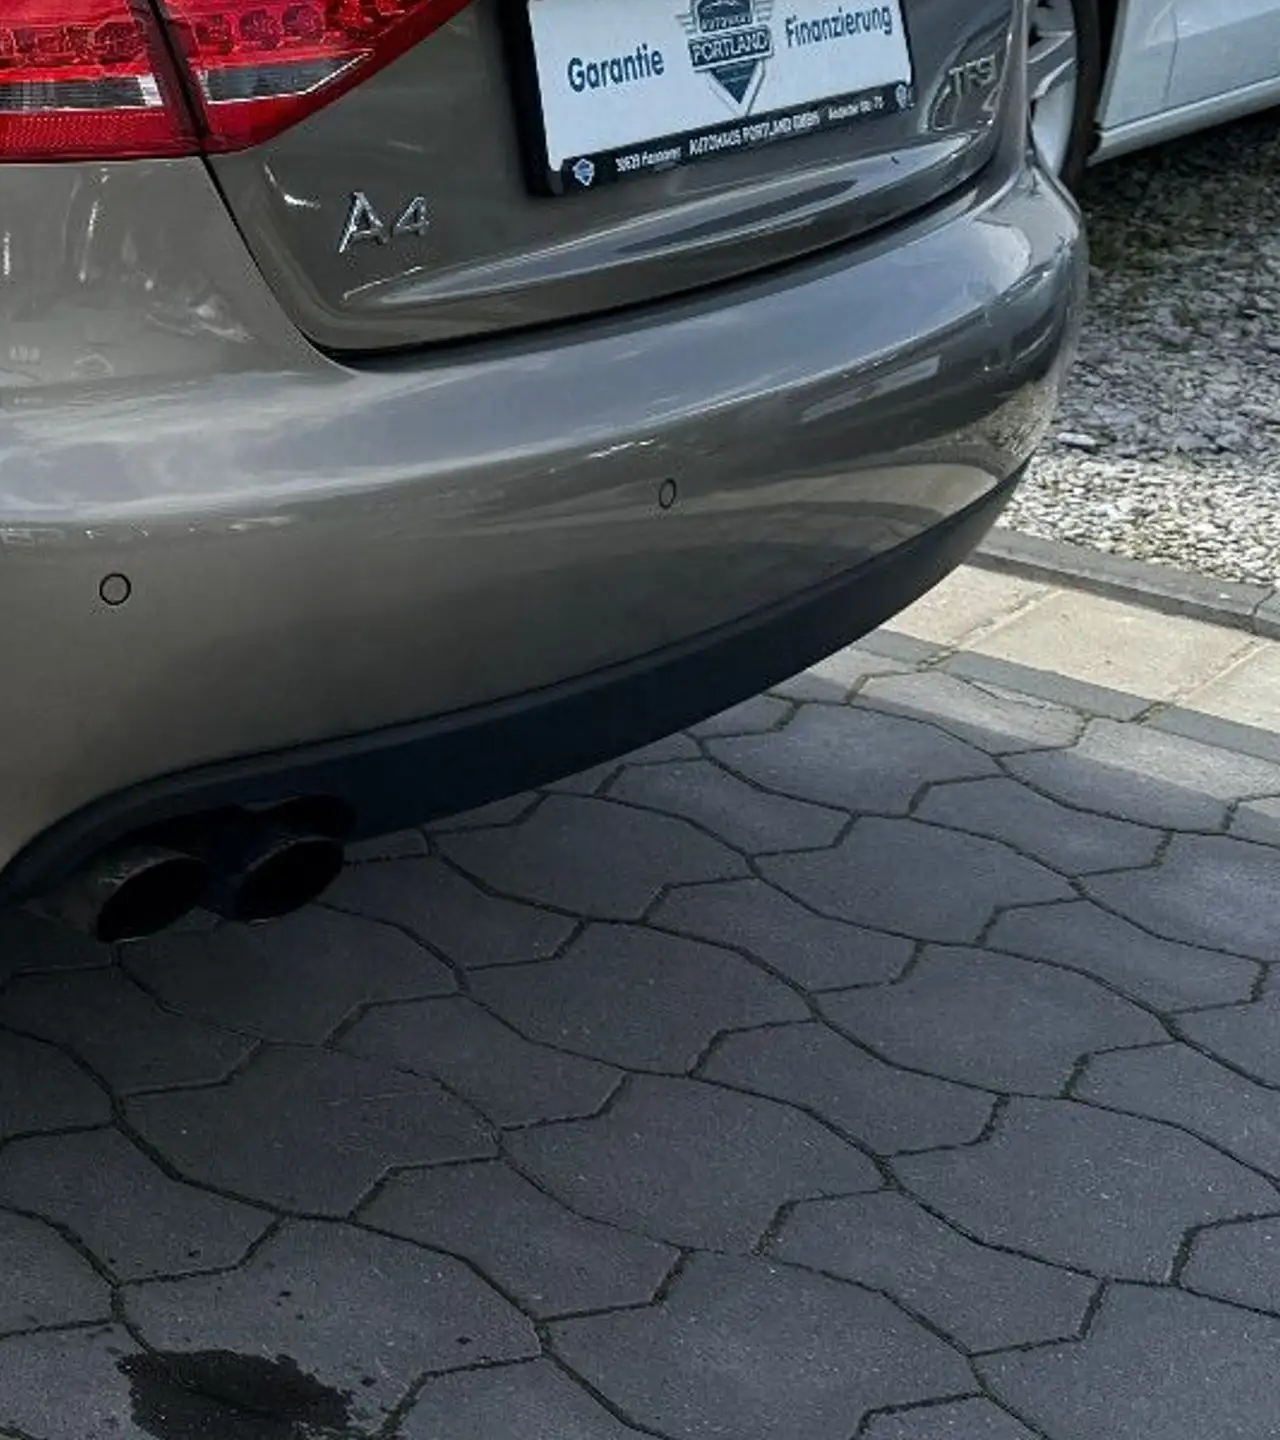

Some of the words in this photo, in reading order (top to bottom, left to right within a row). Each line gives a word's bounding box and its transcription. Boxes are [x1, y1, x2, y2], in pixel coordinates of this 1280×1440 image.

[690, 30, 769, 64] PORTLAND
[784, 4, 893, 50] Finanzierung
[567, 43, 665, 93] Garantie
[338, 191, 430, 253] A4
